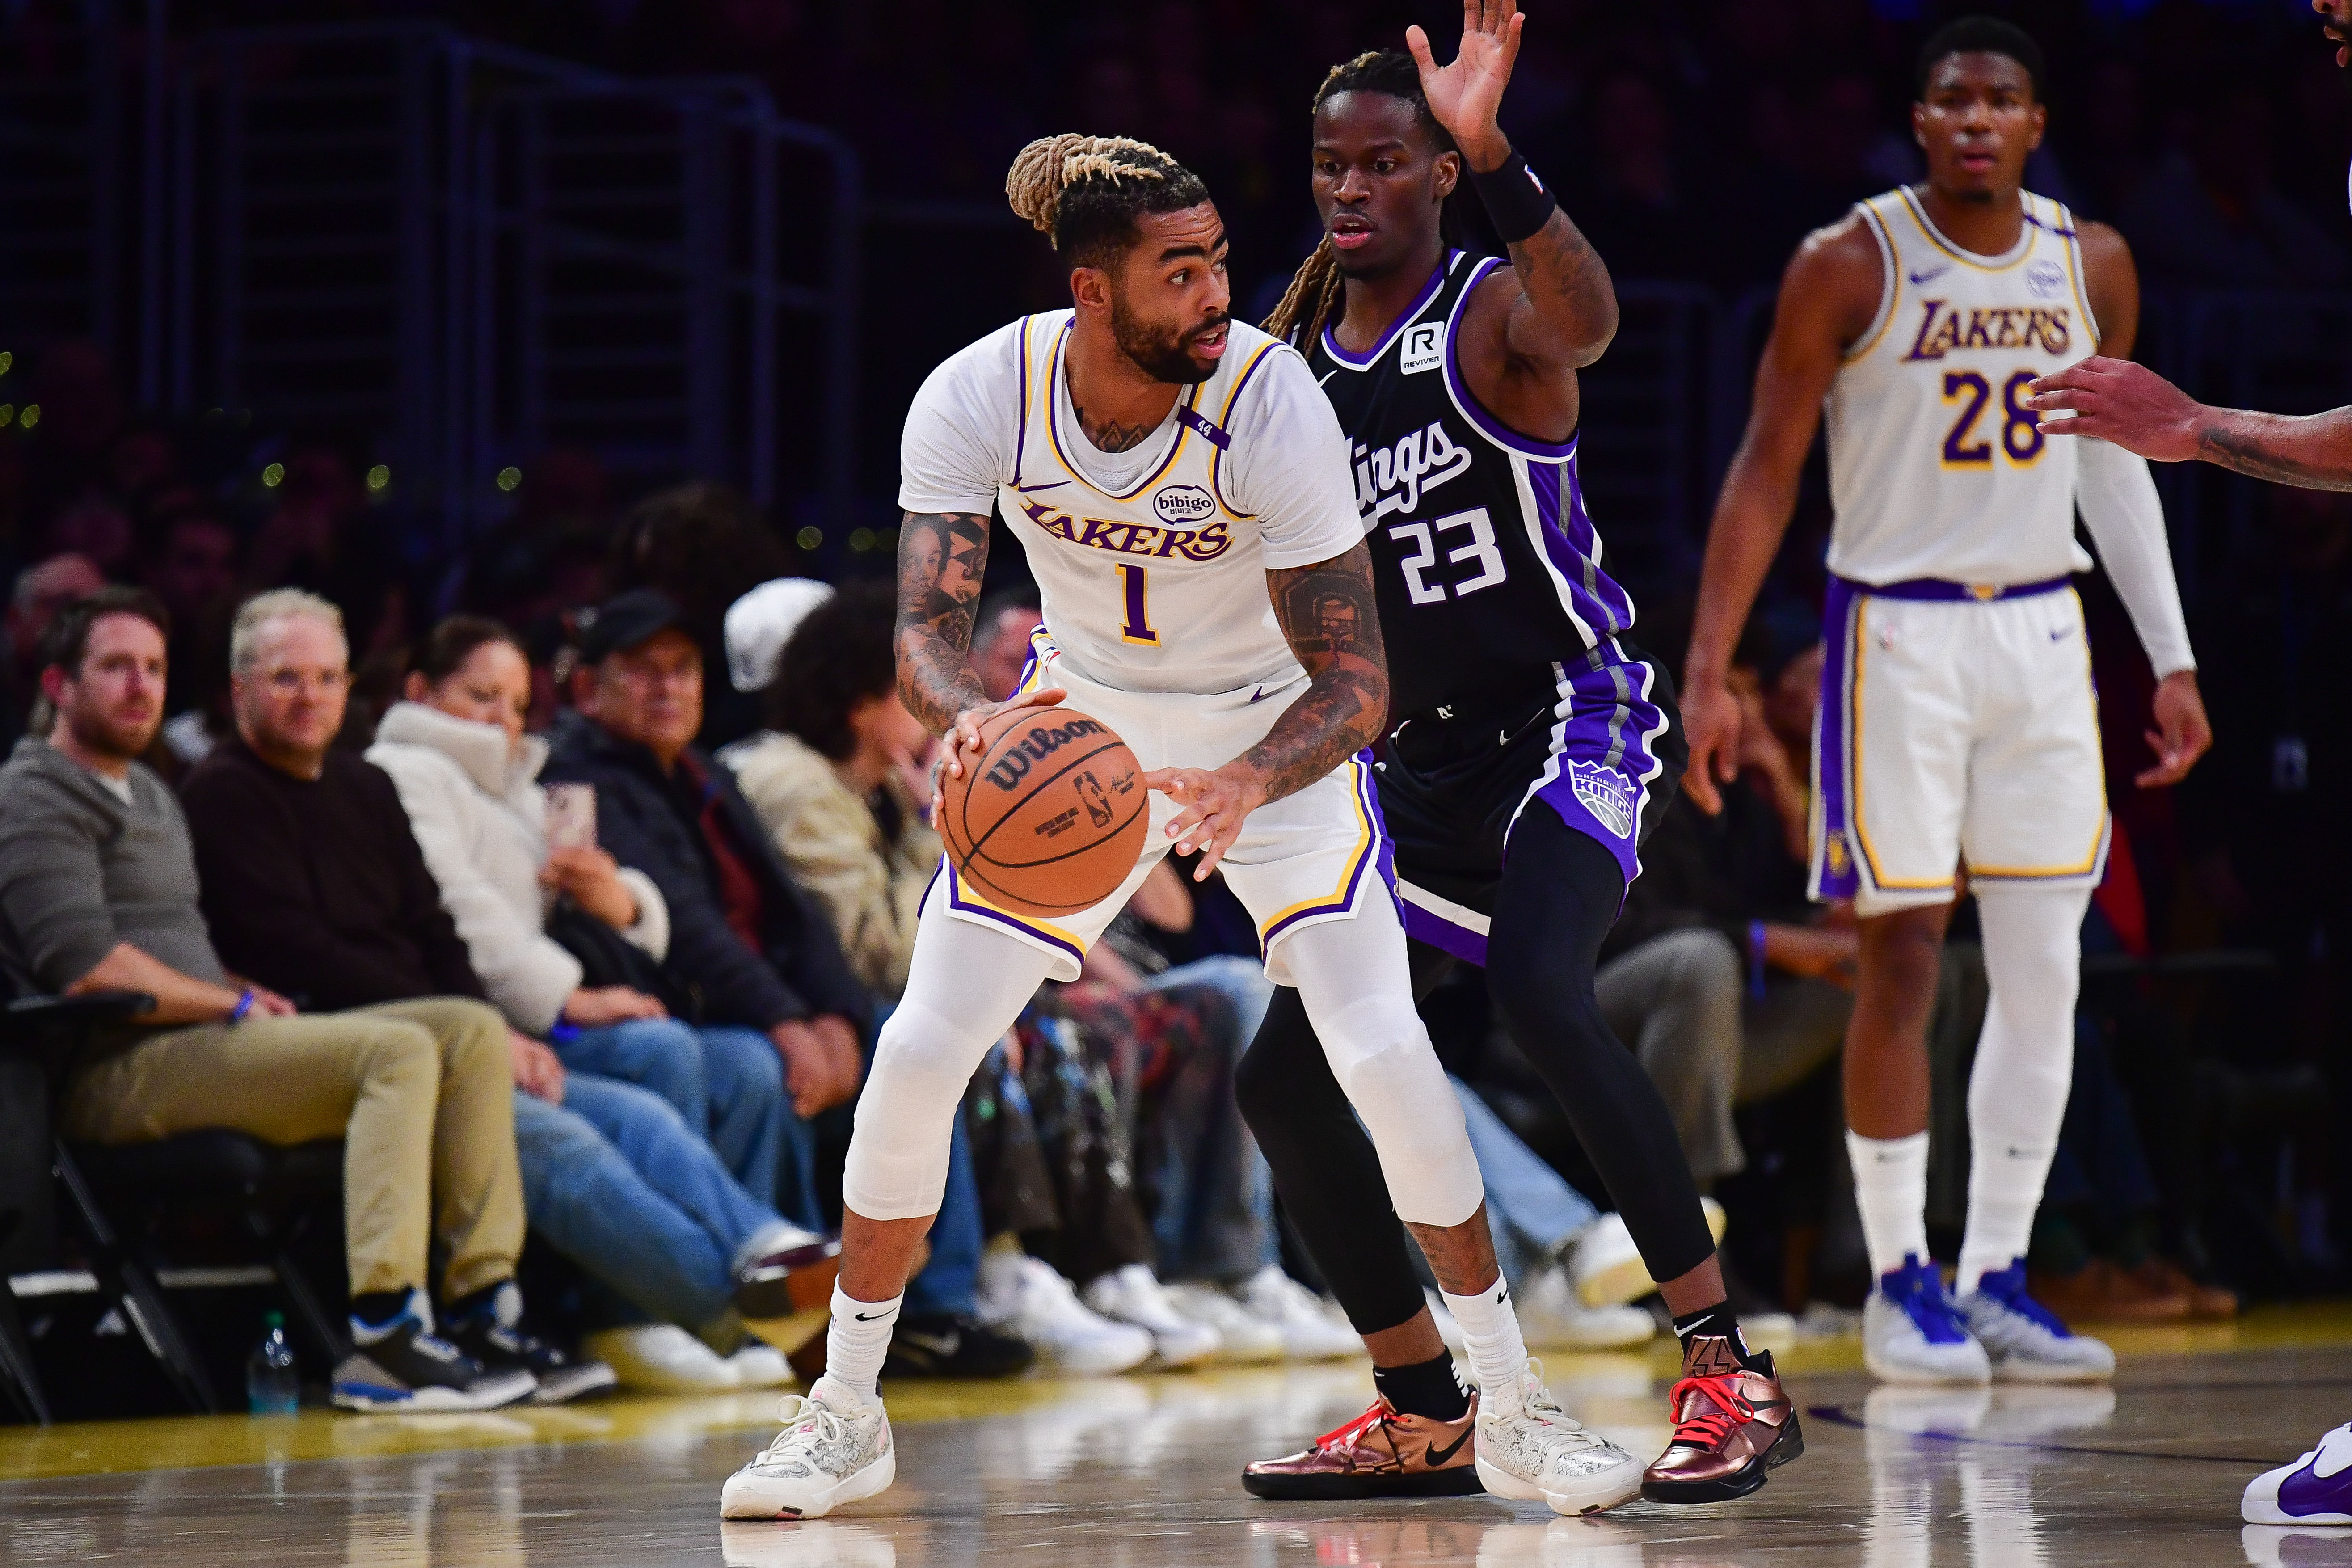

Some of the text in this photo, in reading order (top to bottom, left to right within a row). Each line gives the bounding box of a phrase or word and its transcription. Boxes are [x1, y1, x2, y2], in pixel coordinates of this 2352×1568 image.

[1404, 356, 1439, 369] REVIVER
[1411, 329, 1434, 354] R
[1900, 300, 2069, 363] LAKERS
[1198, 420, 1213, 437] 44
[1940, 368, 2047, 471] 28
[1159, 495, 1212, 512] bibigo
[1345, 419, 1472, 535] ings
[1020, 495, 1235, 562] LAKERS
[1388, 505, 1509, 607] 23
[1116, 562, 1161, 647] 1
[985, 719, 1108, 792] Wilson
[1576, 780, 1631, 825] KINGS
